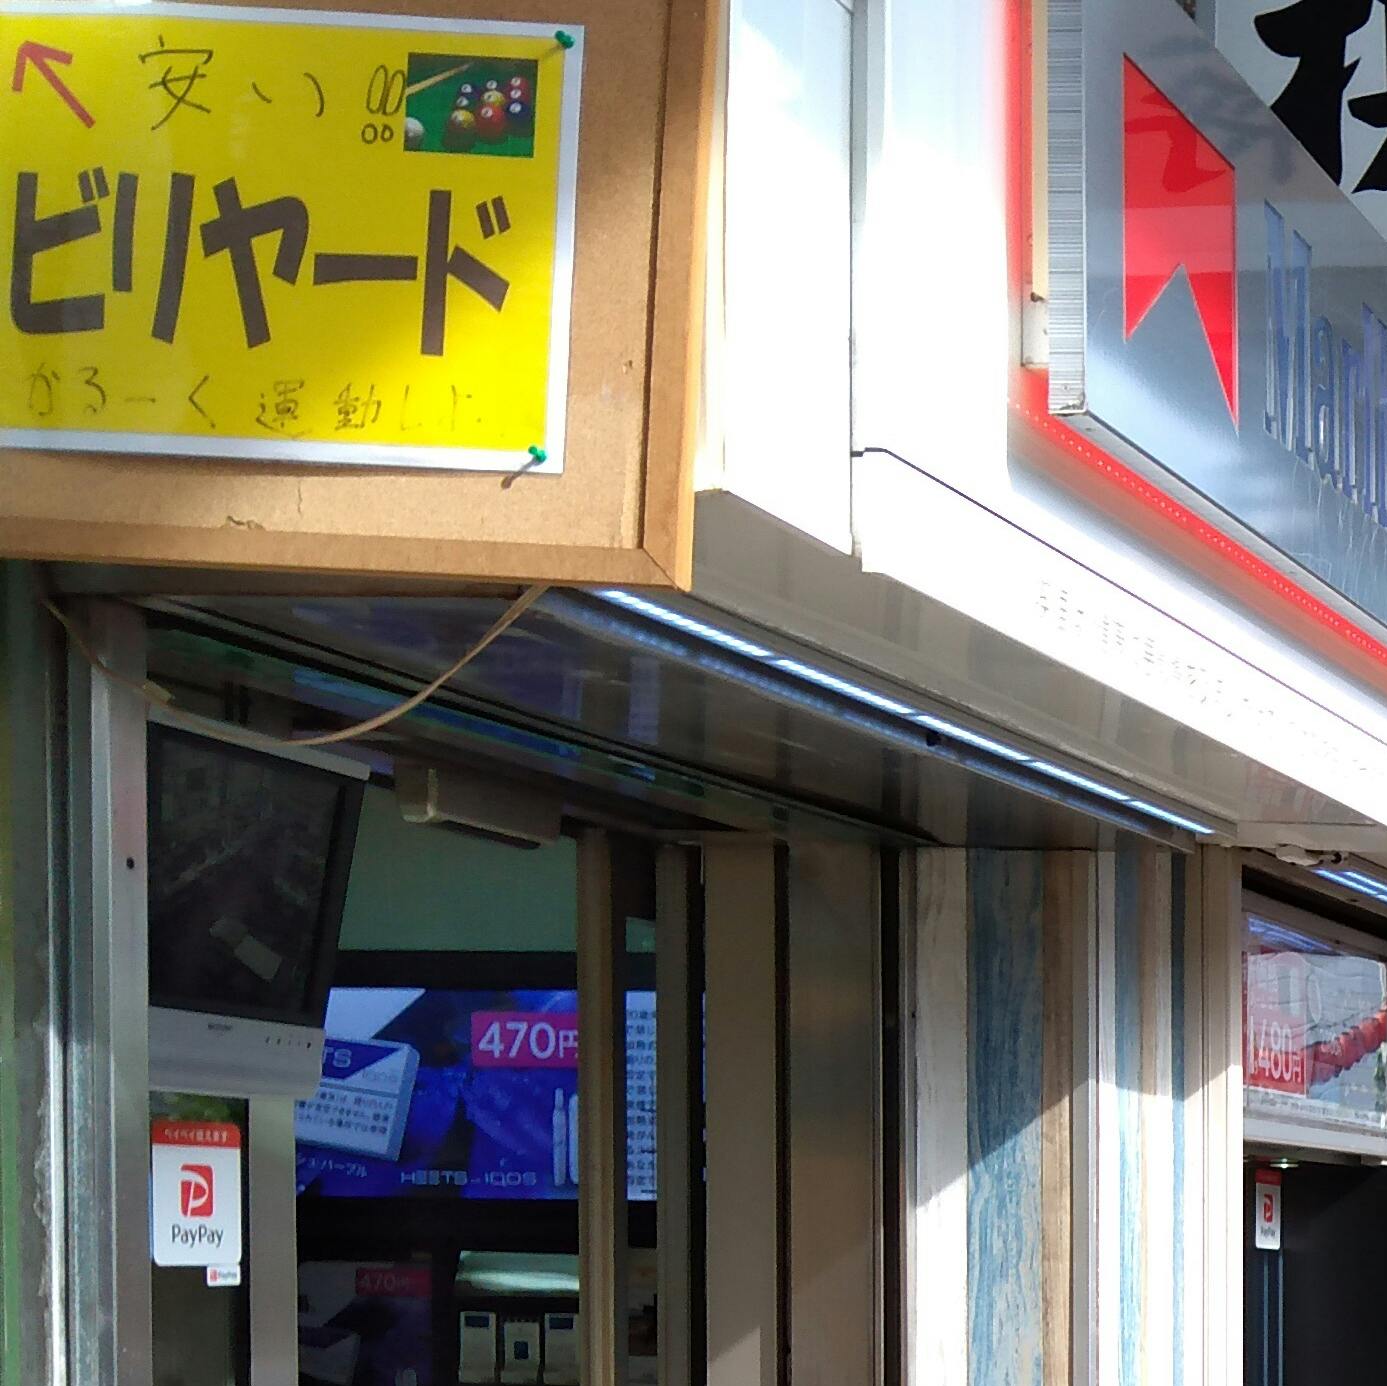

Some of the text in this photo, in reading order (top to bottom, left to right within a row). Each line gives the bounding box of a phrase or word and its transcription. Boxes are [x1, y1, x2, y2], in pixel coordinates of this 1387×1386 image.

[9, 165, 512, 357] ビリヤード
[171, 1223, 225, 1249] PayPay
